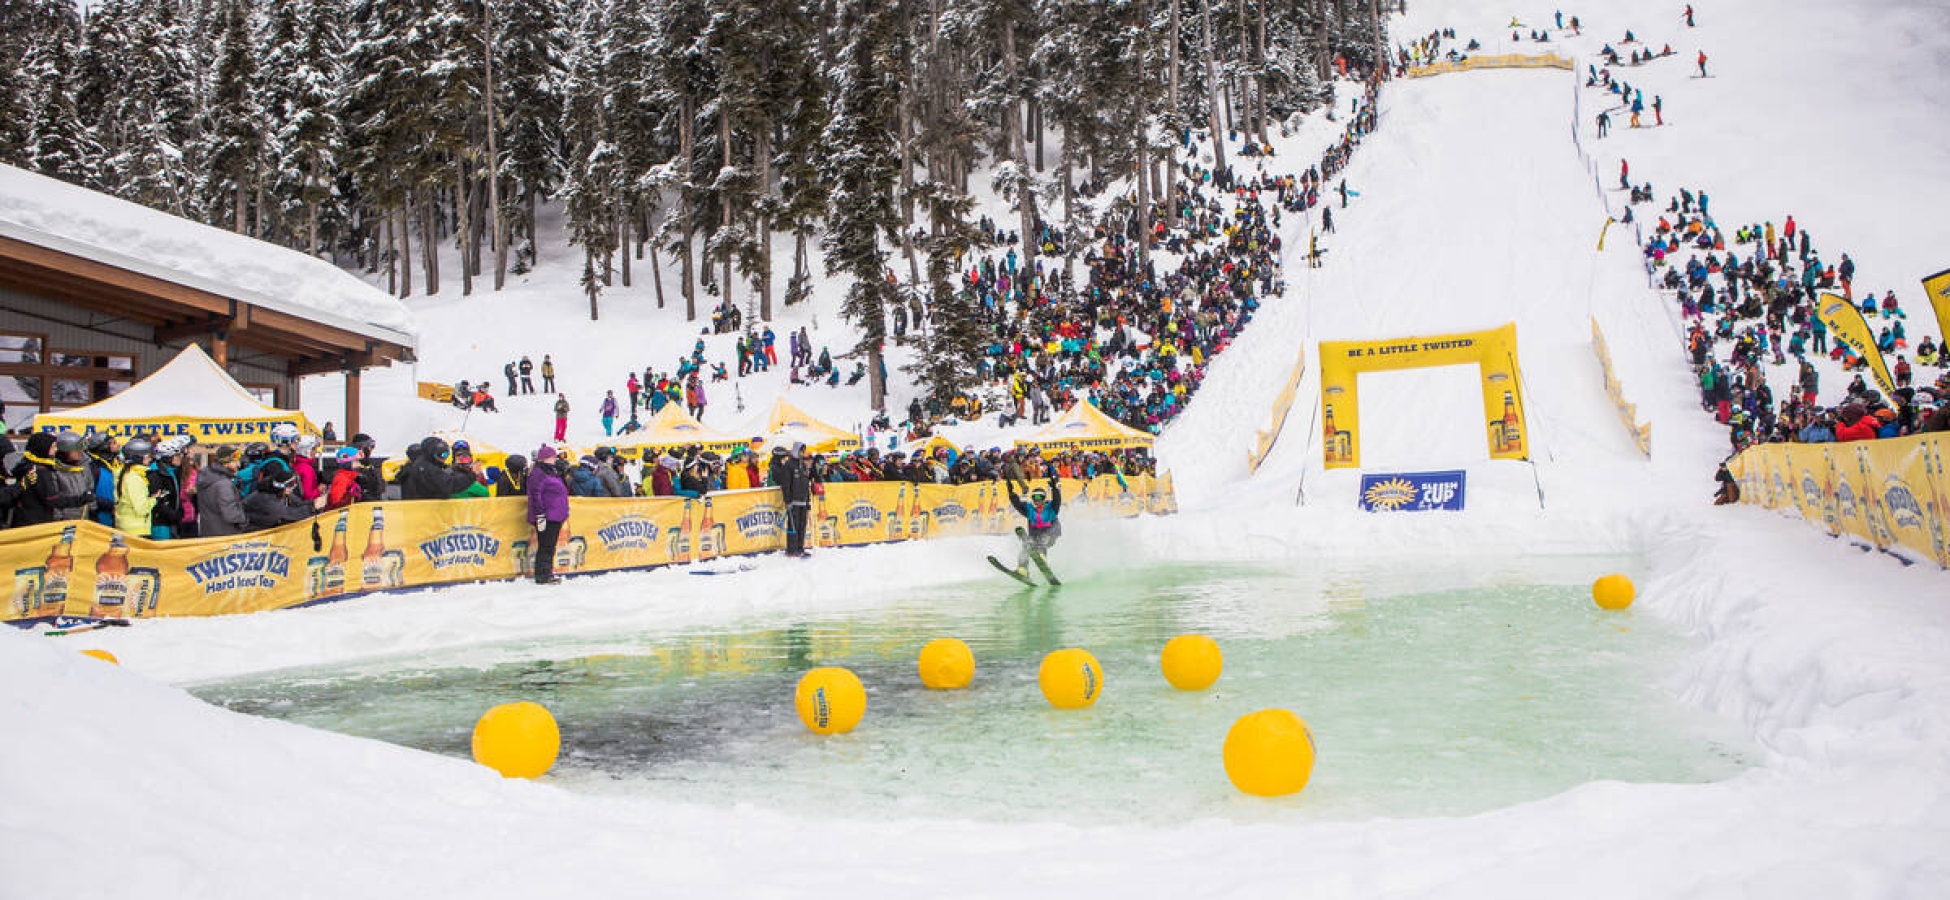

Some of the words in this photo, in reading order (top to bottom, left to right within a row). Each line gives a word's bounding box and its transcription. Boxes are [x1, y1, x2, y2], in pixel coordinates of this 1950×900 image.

[1348, 349, 1363, 357] BE
[1367, 348, 1375, 356] A
[1379, 344, 1418, 355] LITTLE
[1422, 339, 1473, 351] TWISTED
[42, 424, 72, 435] BE
[84, 425, 97, 437] A
[114, 424, 189, 437] LITTLE
[1079, 438, 1121, 447] TWISTED
[1423, 485, 1454, 503] CUP
[736, 511, 774, 532] TWISTED
[597, 521, 643, 546] TWISTED
[642, 520, 659, 541] TEA
[419, 533, 476, 560] TWISTED
[476, 533, 500, 557] TEA
[185, 551, 267, 583] TWISTED
[266, 551, 290, 577] TEA
[205, 577, 235, 594] Hard
[236, 575, 257, 588] Iced
[259, 574, 275, 588] Tea
